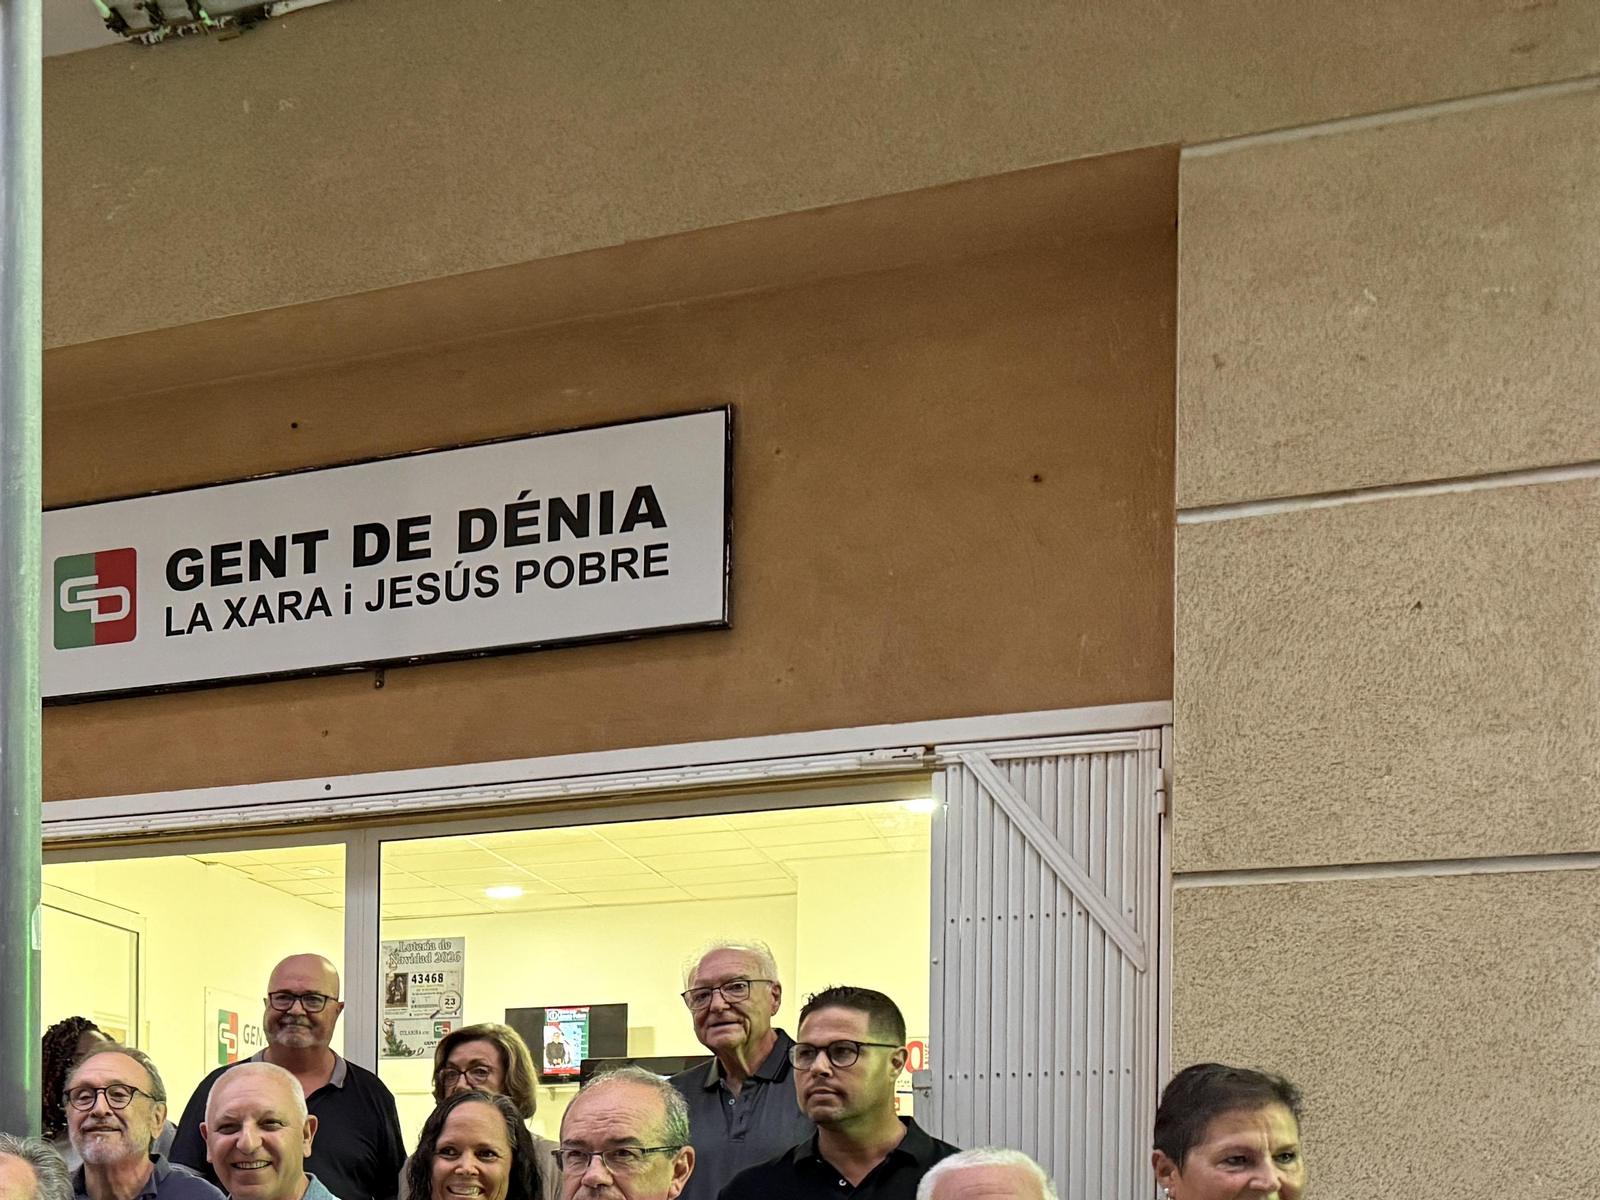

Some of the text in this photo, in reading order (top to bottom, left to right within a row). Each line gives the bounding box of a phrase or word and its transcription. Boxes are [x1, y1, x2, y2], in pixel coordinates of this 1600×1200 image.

[165, 484, 668, 592] GENT DE DÉNIA
[165, 542, 670, 637] LA XARA i JESÚS POBRE
[411, 973, 444, 985] 43468
[444, 998, 456, 1006] 23
[243, 1023, 263, 1047] GEN
